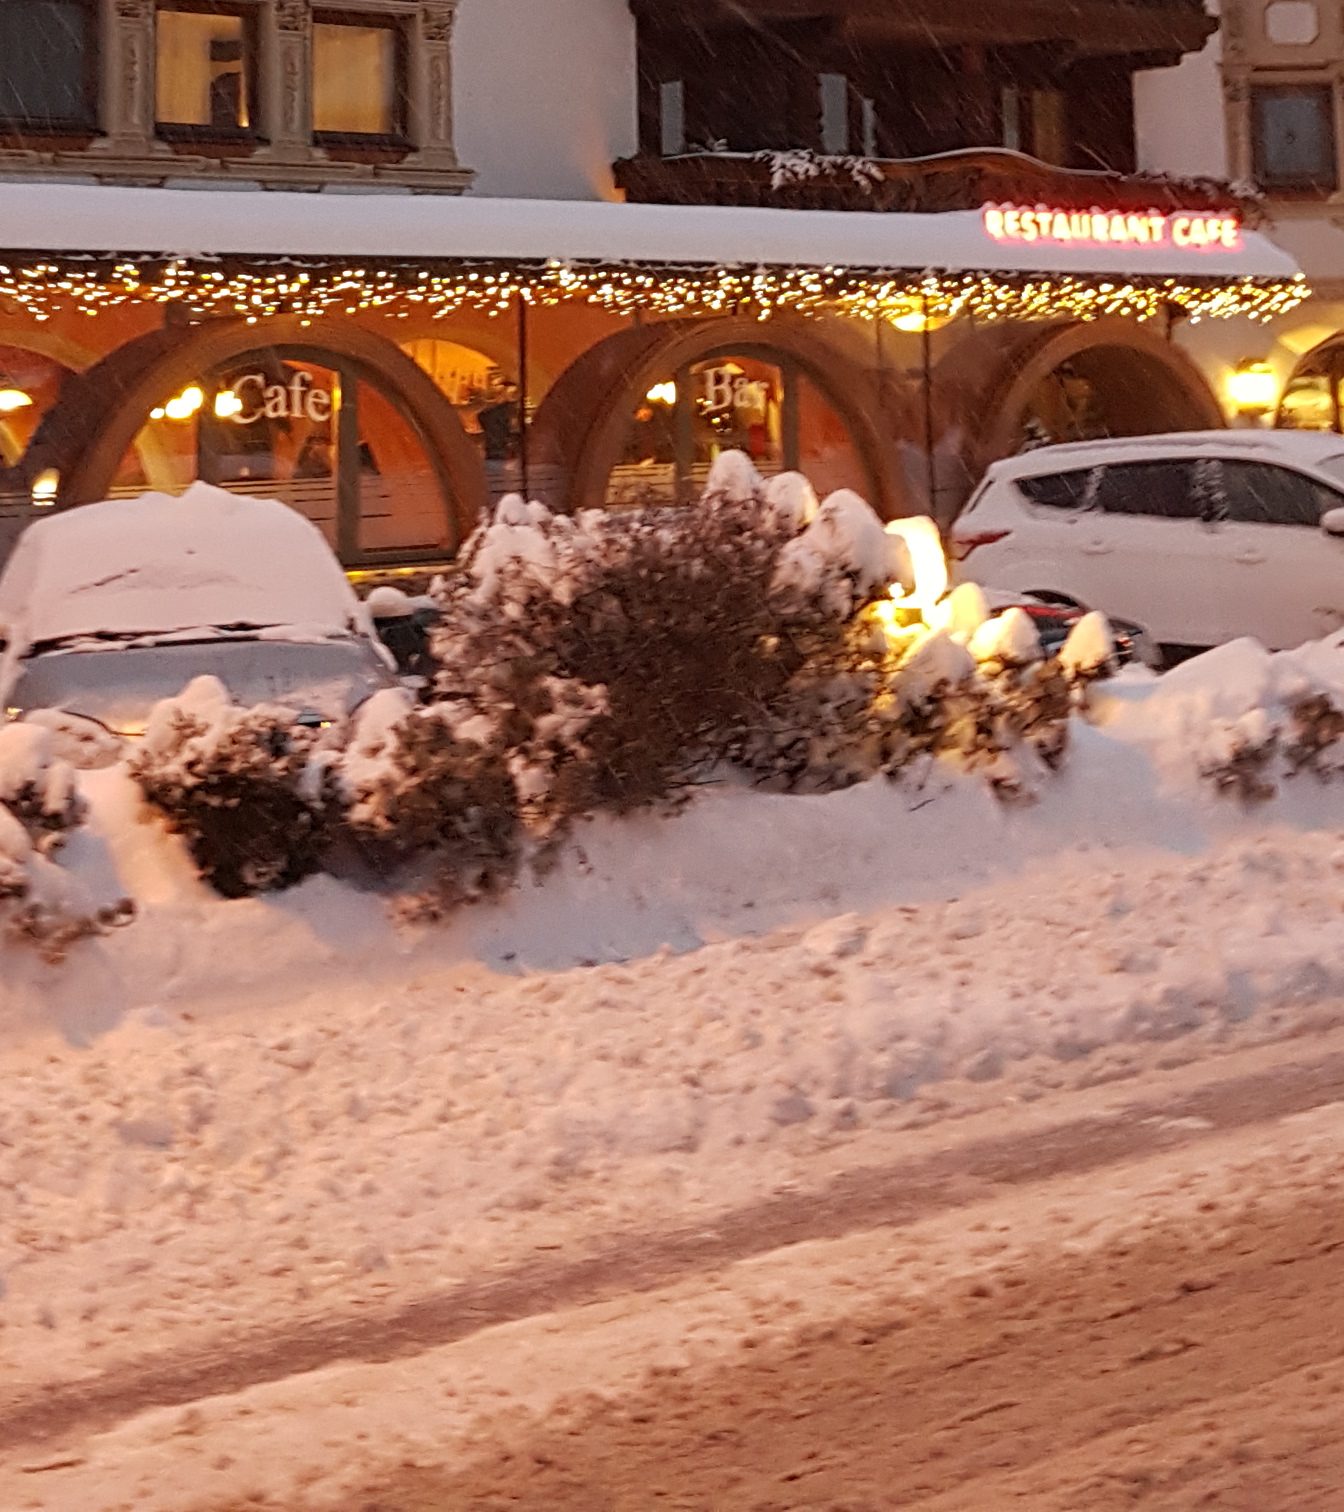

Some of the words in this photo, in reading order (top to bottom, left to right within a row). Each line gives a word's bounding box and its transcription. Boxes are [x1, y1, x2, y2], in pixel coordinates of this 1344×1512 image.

[984, 208, 1165, 243] RESTAURANT
[1172, 217, 1238, 247] CAFE
[228, 371, 331, 424] Cafe
[699, 366, 770, 416] Bar
